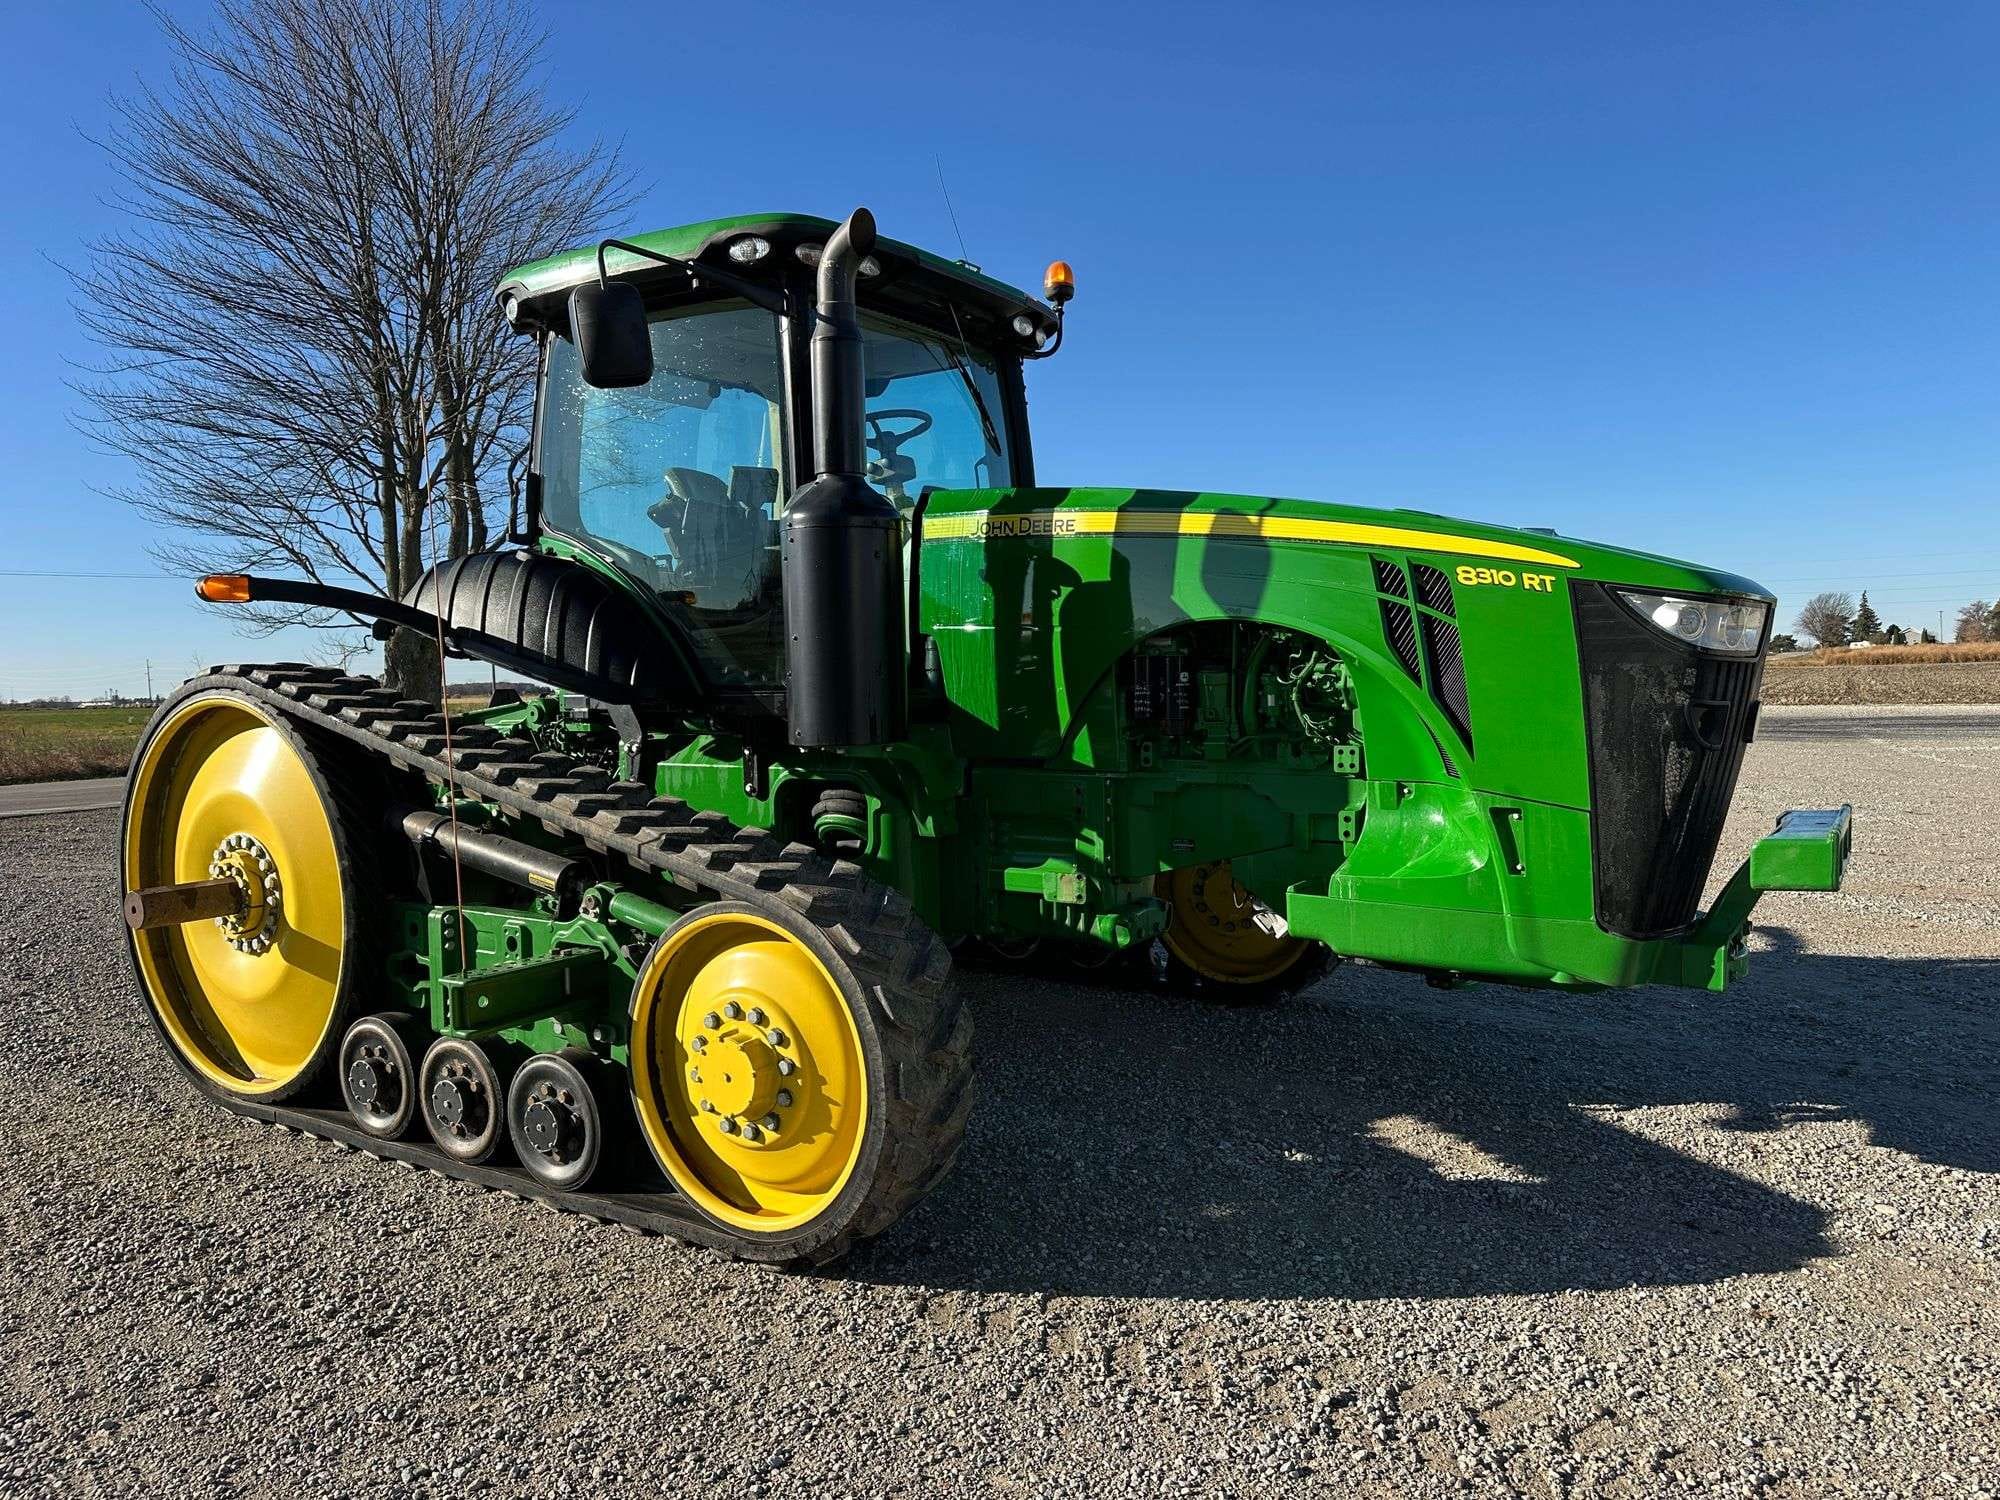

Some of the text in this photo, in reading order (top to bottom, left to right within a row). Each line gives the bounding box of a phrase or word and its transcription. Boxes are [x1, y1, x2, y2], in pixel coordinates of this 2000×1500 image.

[970, 517, 1076, 536] JOHN DEERE
[1456, 565, 1556, 593] 8310 RT
